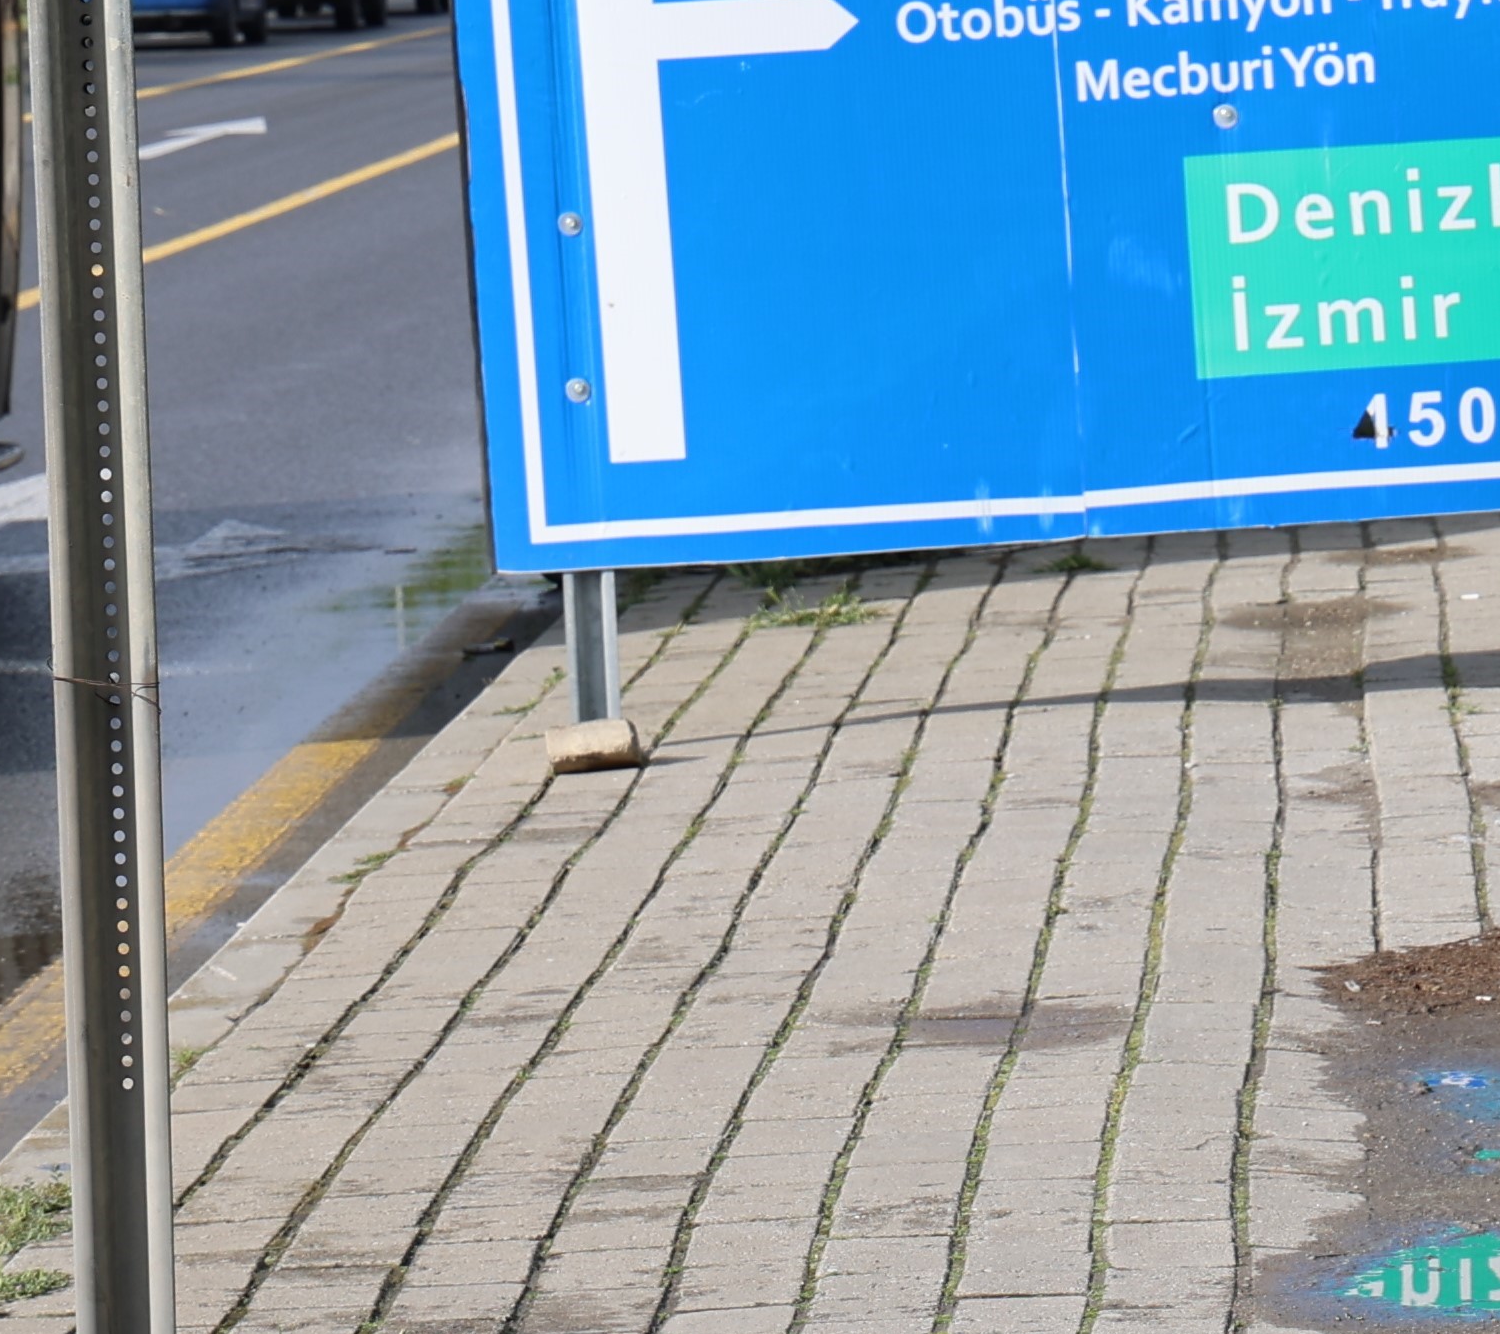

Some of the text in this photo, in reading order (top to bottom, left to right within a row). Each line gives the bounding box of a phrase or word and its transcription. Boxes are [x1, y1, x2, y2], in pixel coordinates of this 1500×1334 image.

[1074, 42, 1376, 102] Mecburi Yön
[1231, 275, 1461, 352] İzmir
